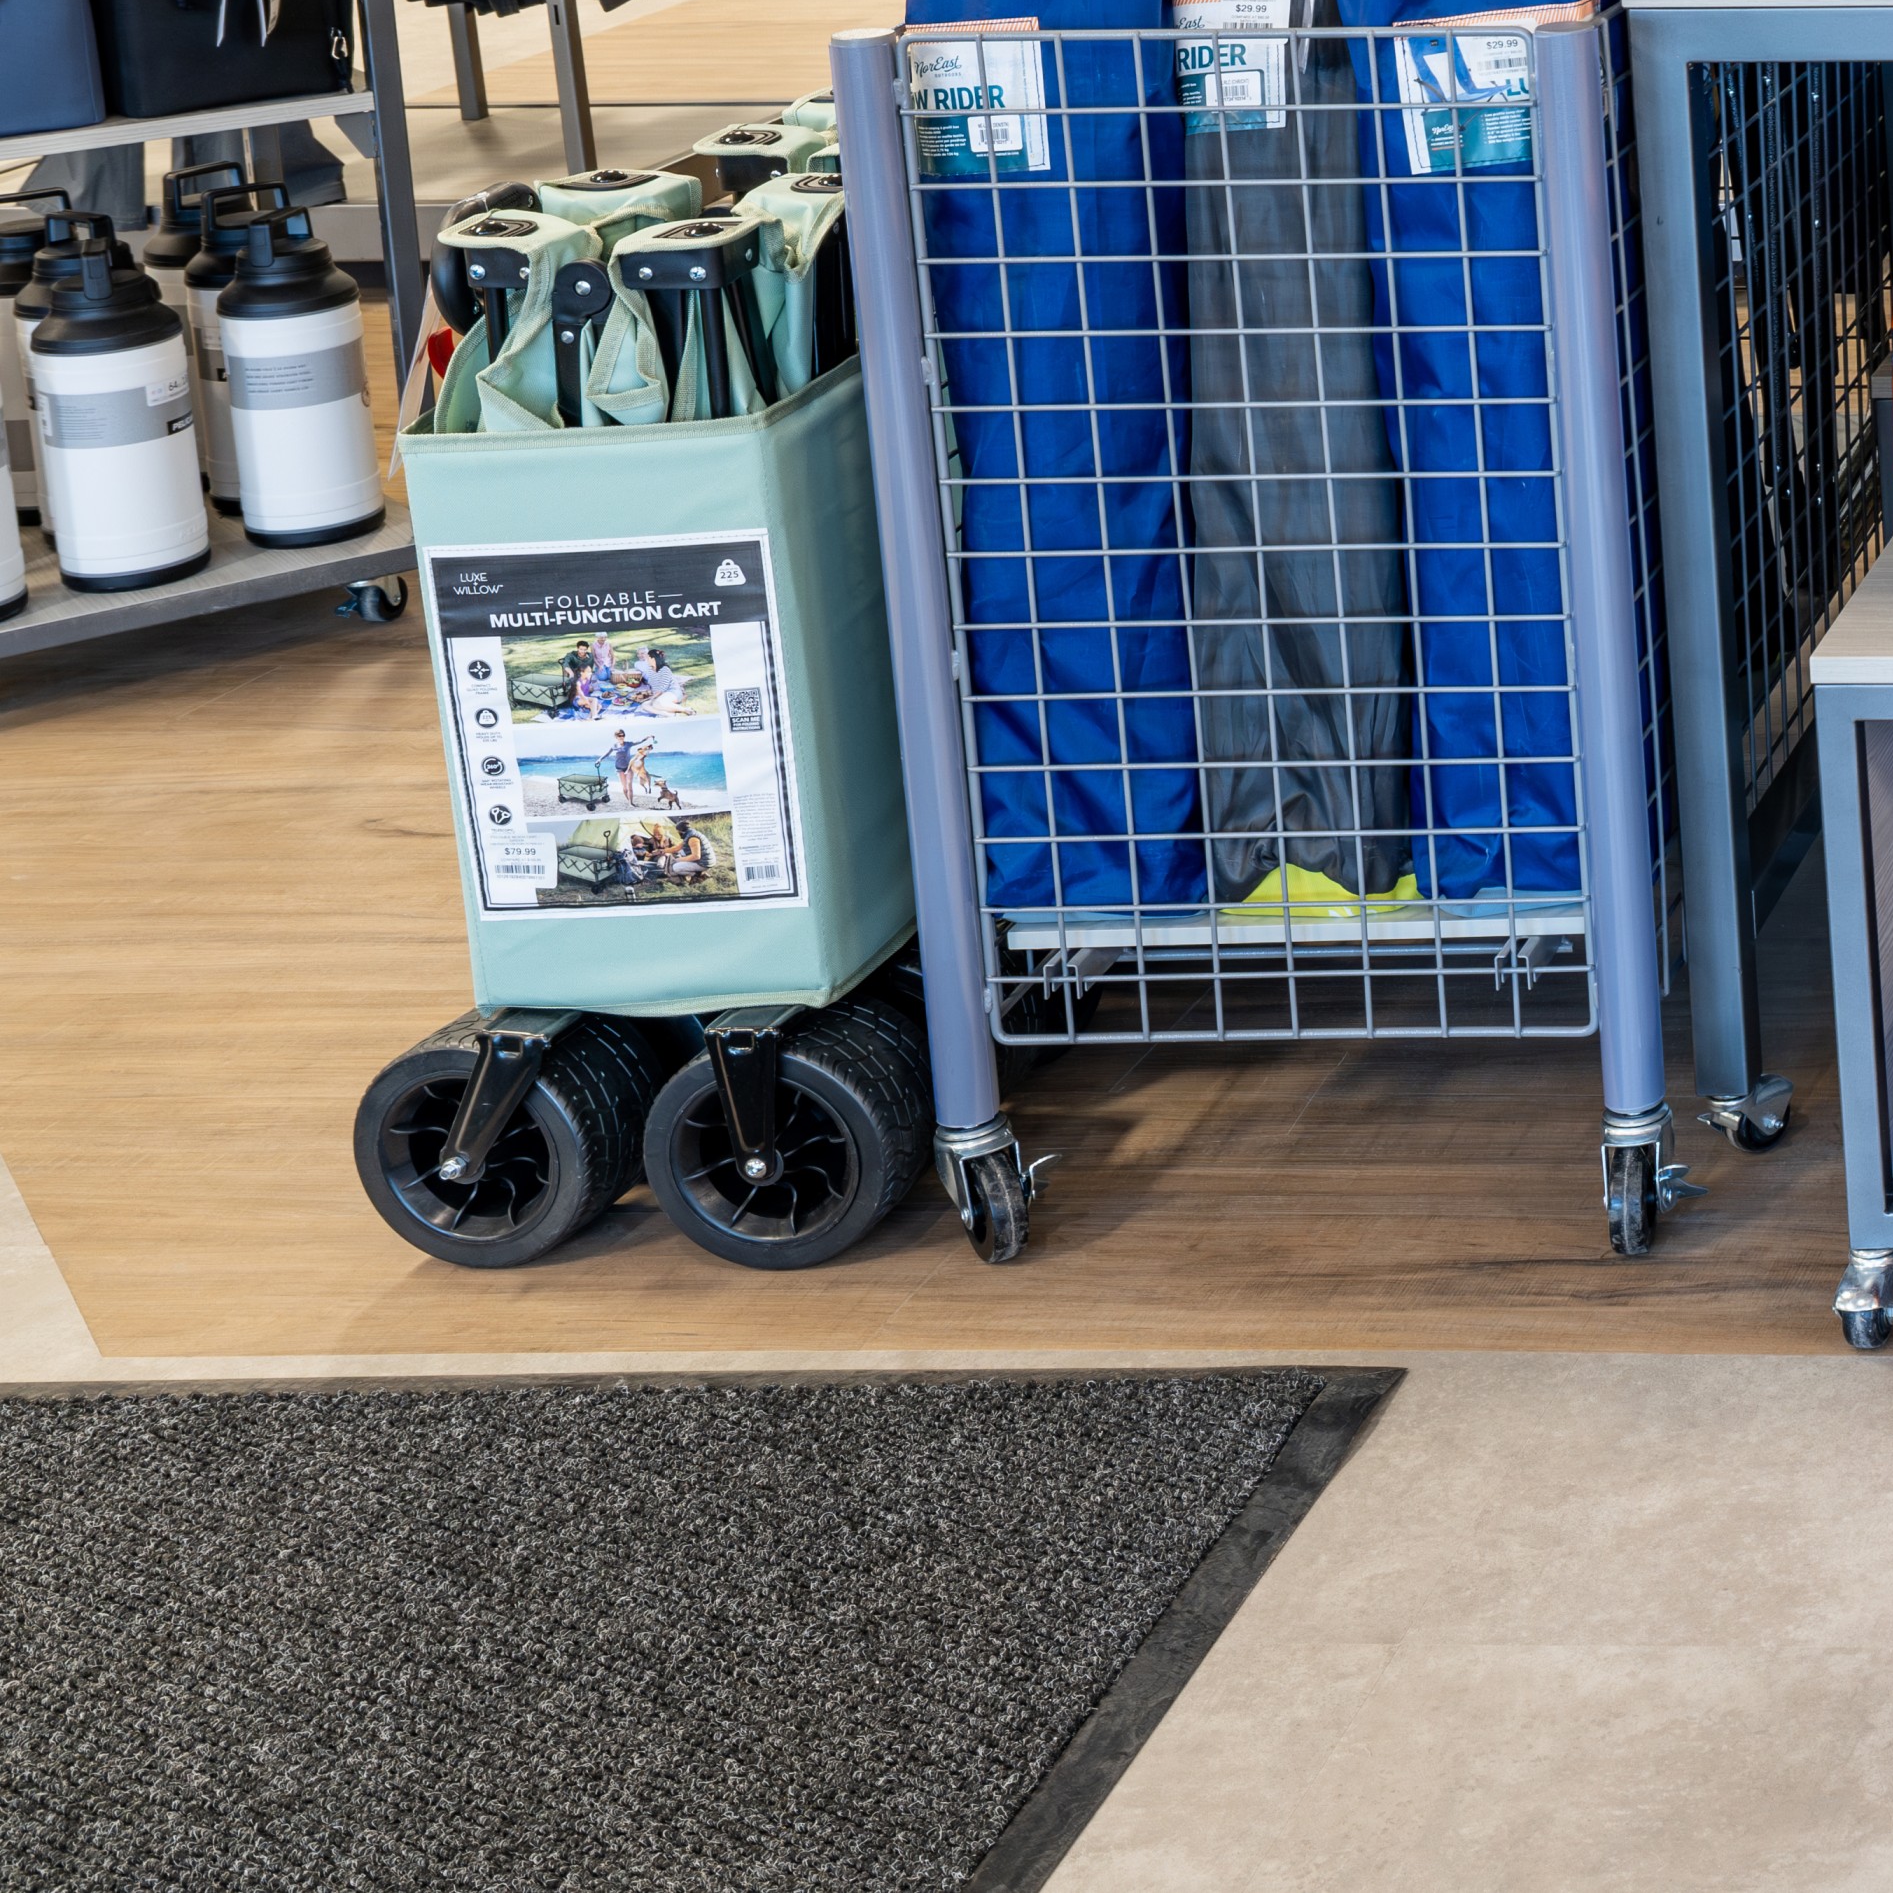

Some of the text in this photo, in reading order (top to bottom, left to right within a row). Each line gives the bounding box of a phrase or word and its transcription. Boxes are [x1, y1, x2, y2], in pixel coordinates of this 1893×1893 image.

[1236, 4, 1266, 12] $29.99
[914, 55, 962, 76] NorEast
[1177, 44, 1246, 71] RIDER
[934, 85, 1005, 110] RIDER
[460, 572, 487, 582] LUXE
[720, 570, 739, 579] 225
[545, 590, 656, 609] FOLDABLE
[490, 601, 721, 629] MULTI-FUNCTION CART
[504, 847, 536, 856] $79.99
